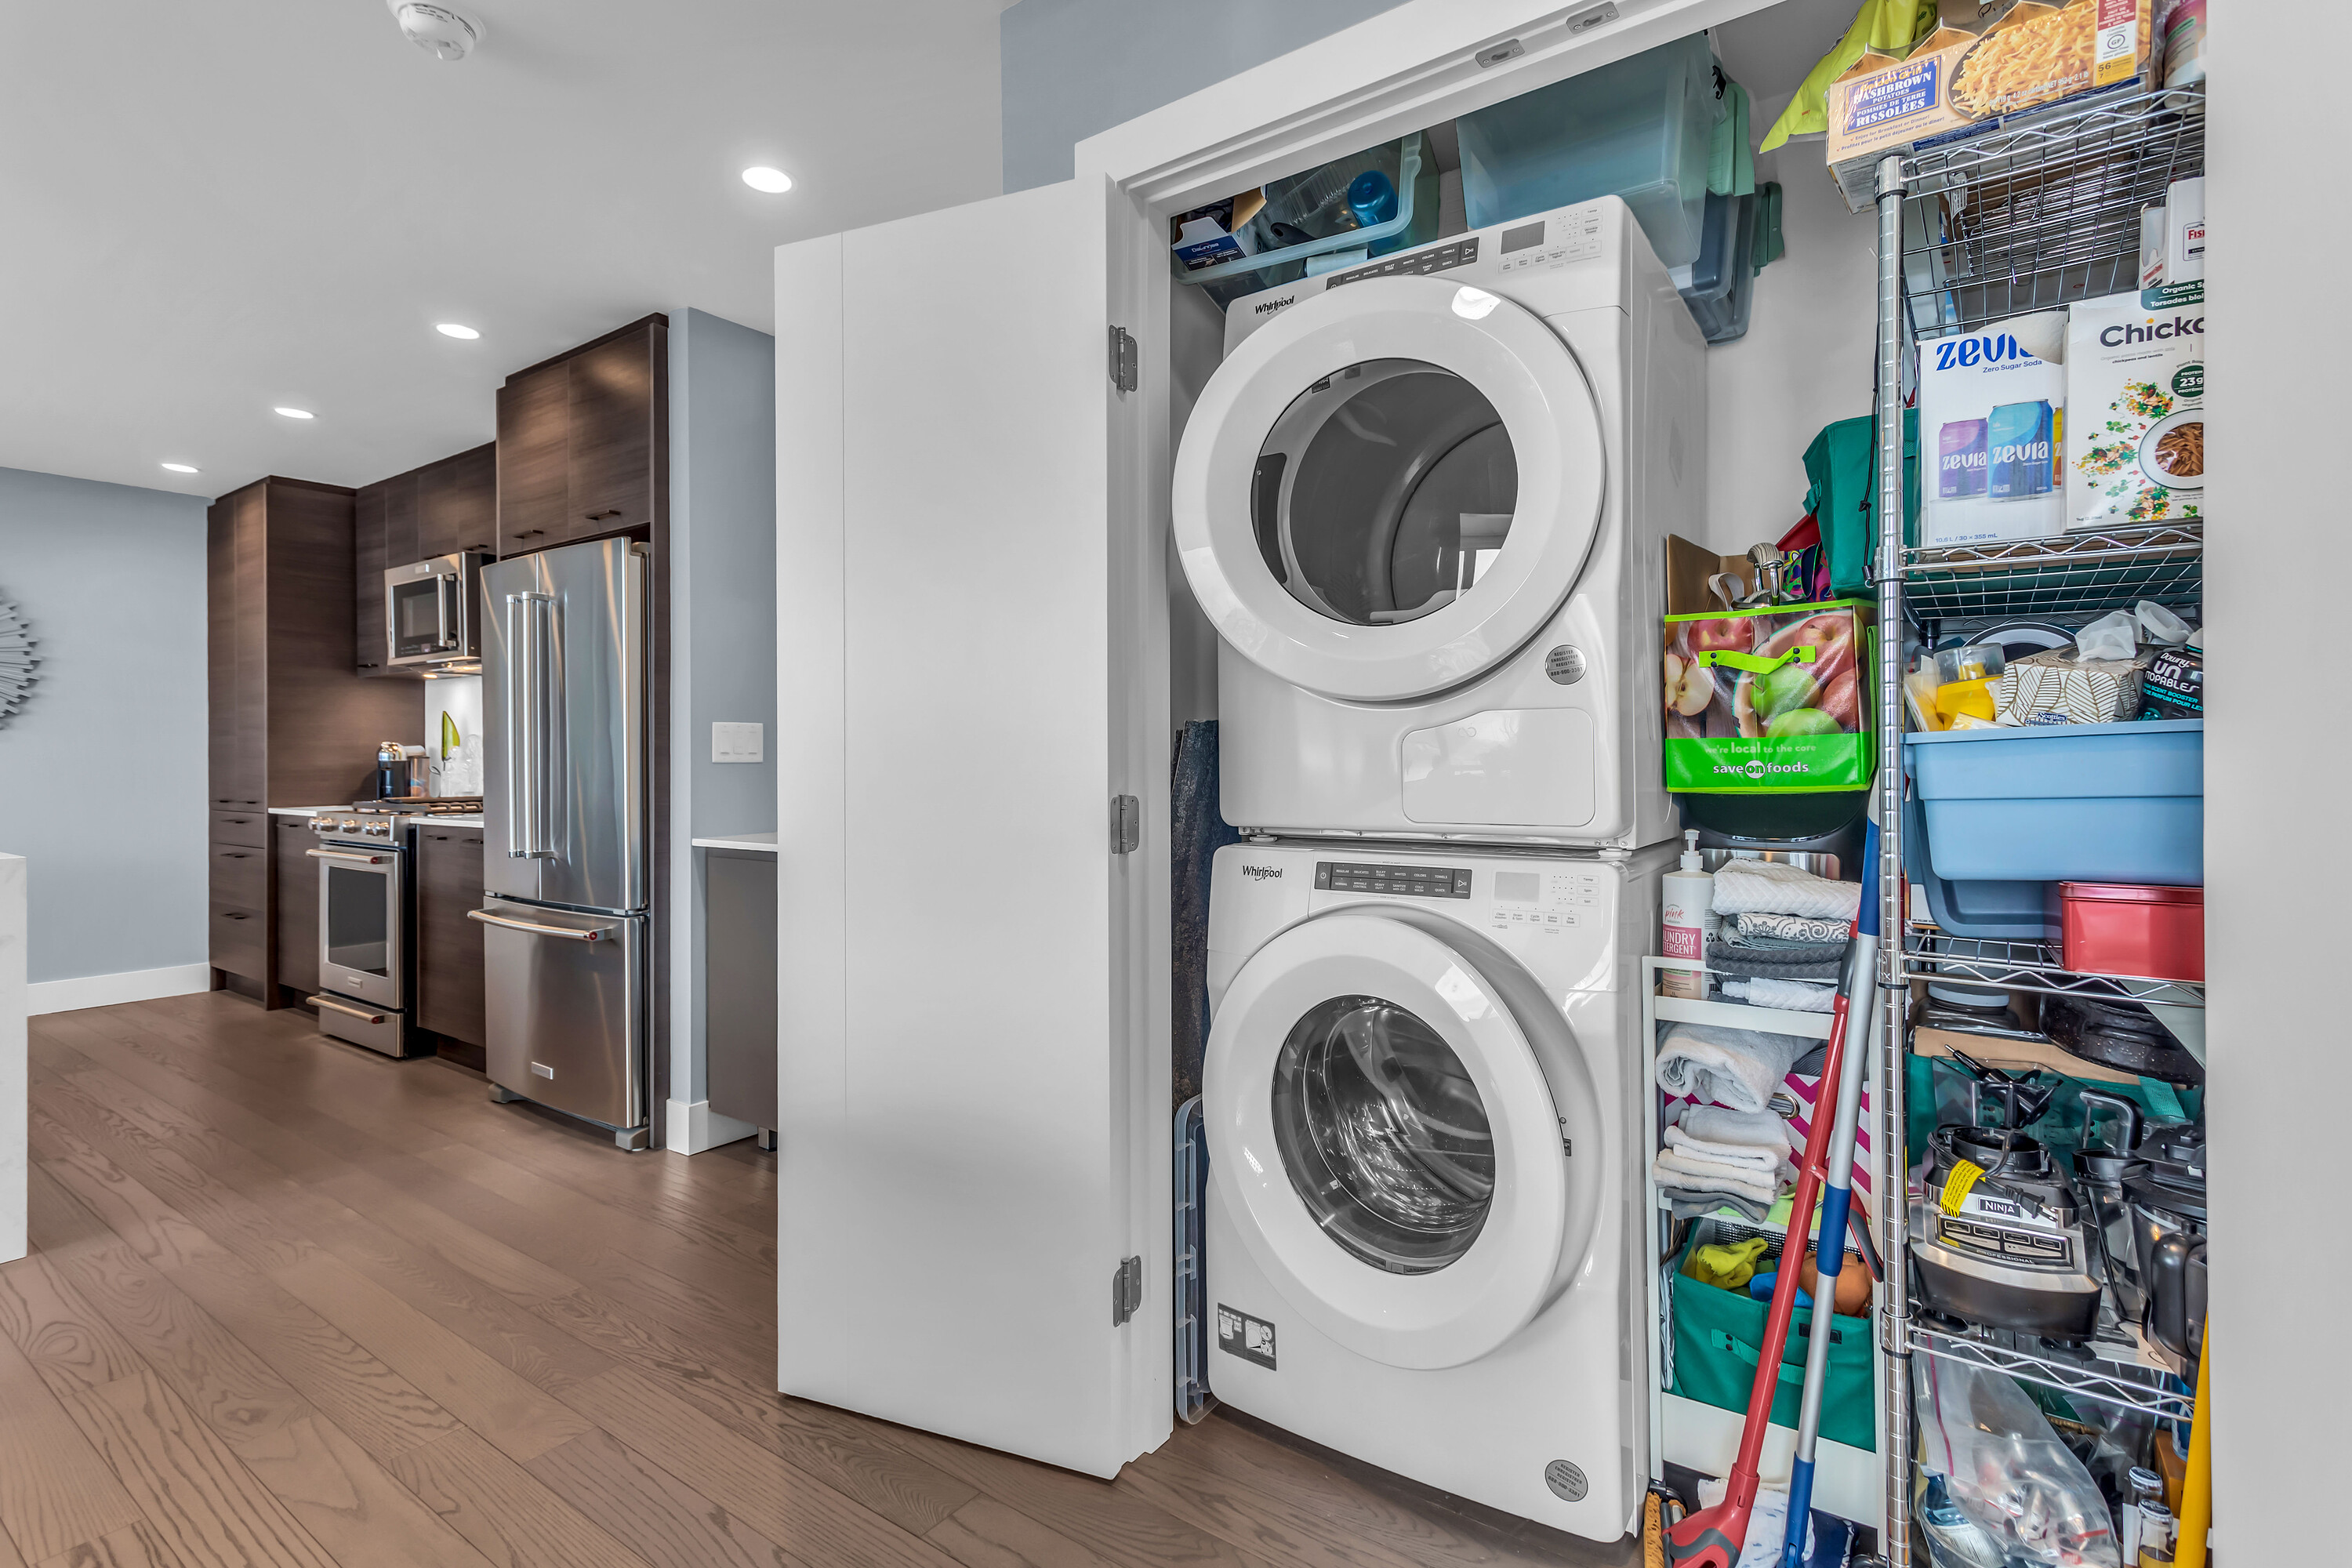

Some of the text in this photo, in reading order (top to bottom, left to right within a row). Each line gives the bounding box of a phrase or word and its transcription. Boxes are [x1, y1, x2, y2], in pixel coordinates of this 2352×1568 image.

[1853, 71, 1932, 104] HASHBROWN
[1872, 88, 1910, 103] POTATOES
[1857, 103, 1887, 117] POMMES
[1901, 91, 1926, 103] TERRE
[1857, 98, 1925, 127] RISSOLÉES
[2162, 284, 2195, 294] Organic
[1255, 295, 1294, 314] Whirlpool
[2151, 297, 2187, 307] Torsades
[1936, 333, 2034, 371] zevi
[1992, 441, 2049, 464] zevia
[1943, 452, 1987, 470] zevia
[1551, 654, 1578, 662] ENREGISTRER
[2151, 691, 2172, 702] PARFUM
[2172, 698, 2190, 707] POUR
[2168, 691, 2198, 703] BOOSTER
[2038, 712, 2065, 720] Scotties
[1705, 745, 1729, 753] we're
[1731, 742, 1760, 753] local
[1777, 744, 1792, 753] the
[1243, 866, 1282, 880] Whirlpool
[1664, 908, 1684, 921] pink
[1985, 1200, 2015, 1214] NINJA
[1976, 1250, 2034, 1264] PROFESSIONAL
[1555, 1466, 1582, 1484] ENREGISTRER
[1561, 1464, 1580, 1477] REGISTER
